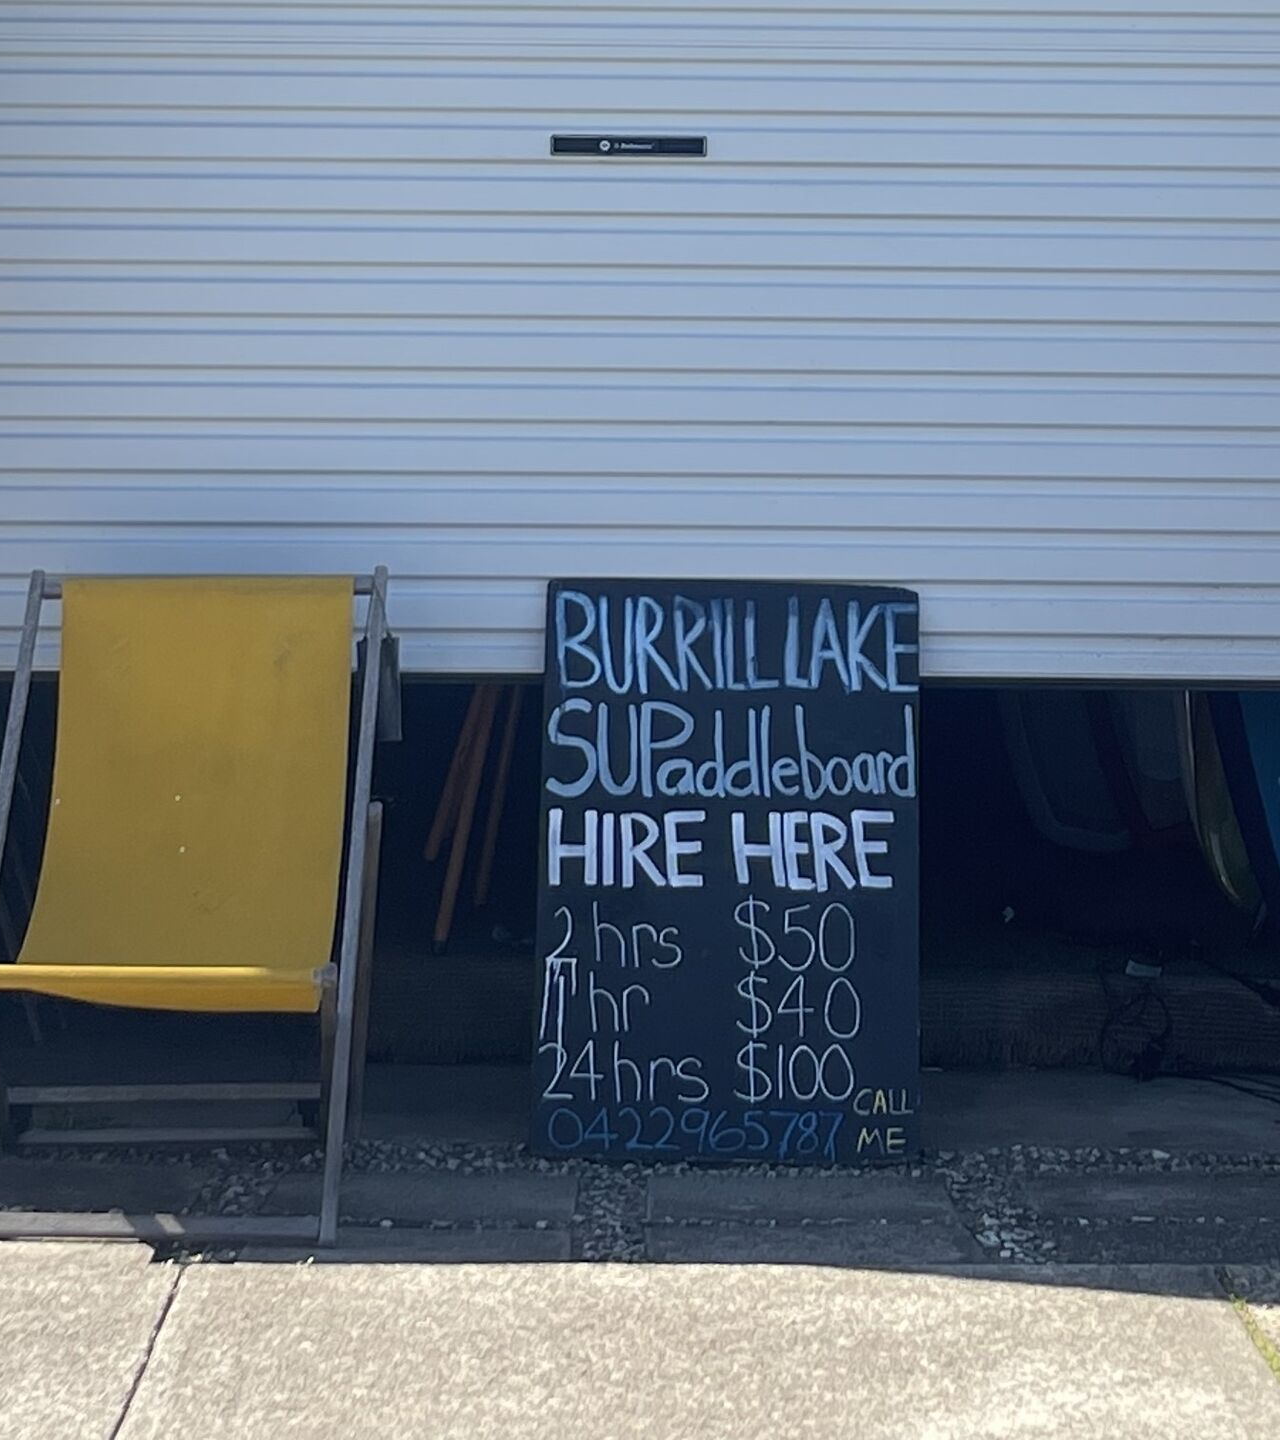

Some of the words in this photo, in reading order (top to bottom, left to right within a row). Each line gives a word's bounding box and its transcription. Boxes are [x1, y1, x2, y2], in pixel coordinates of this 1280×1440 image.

[556, 590, 779, 694] BURRILL
[784, 594, 919, 694] LAKE
[547, 808, 706, 888] HIRE
[731, 811, 895, 890] HERE
[593, 901, 683, 968] hrs
[734, 894, 856, 972] $50
[589, 971, 650, 1032] hr
[736, 971, 861, 1039] $40
[734, 1040, 855, 1103] $100
[853, 1089, 914, 1116] CALL
[547, 1107, 846, 1158] 0422965787
[856, 1127, 907, 1154] ME
